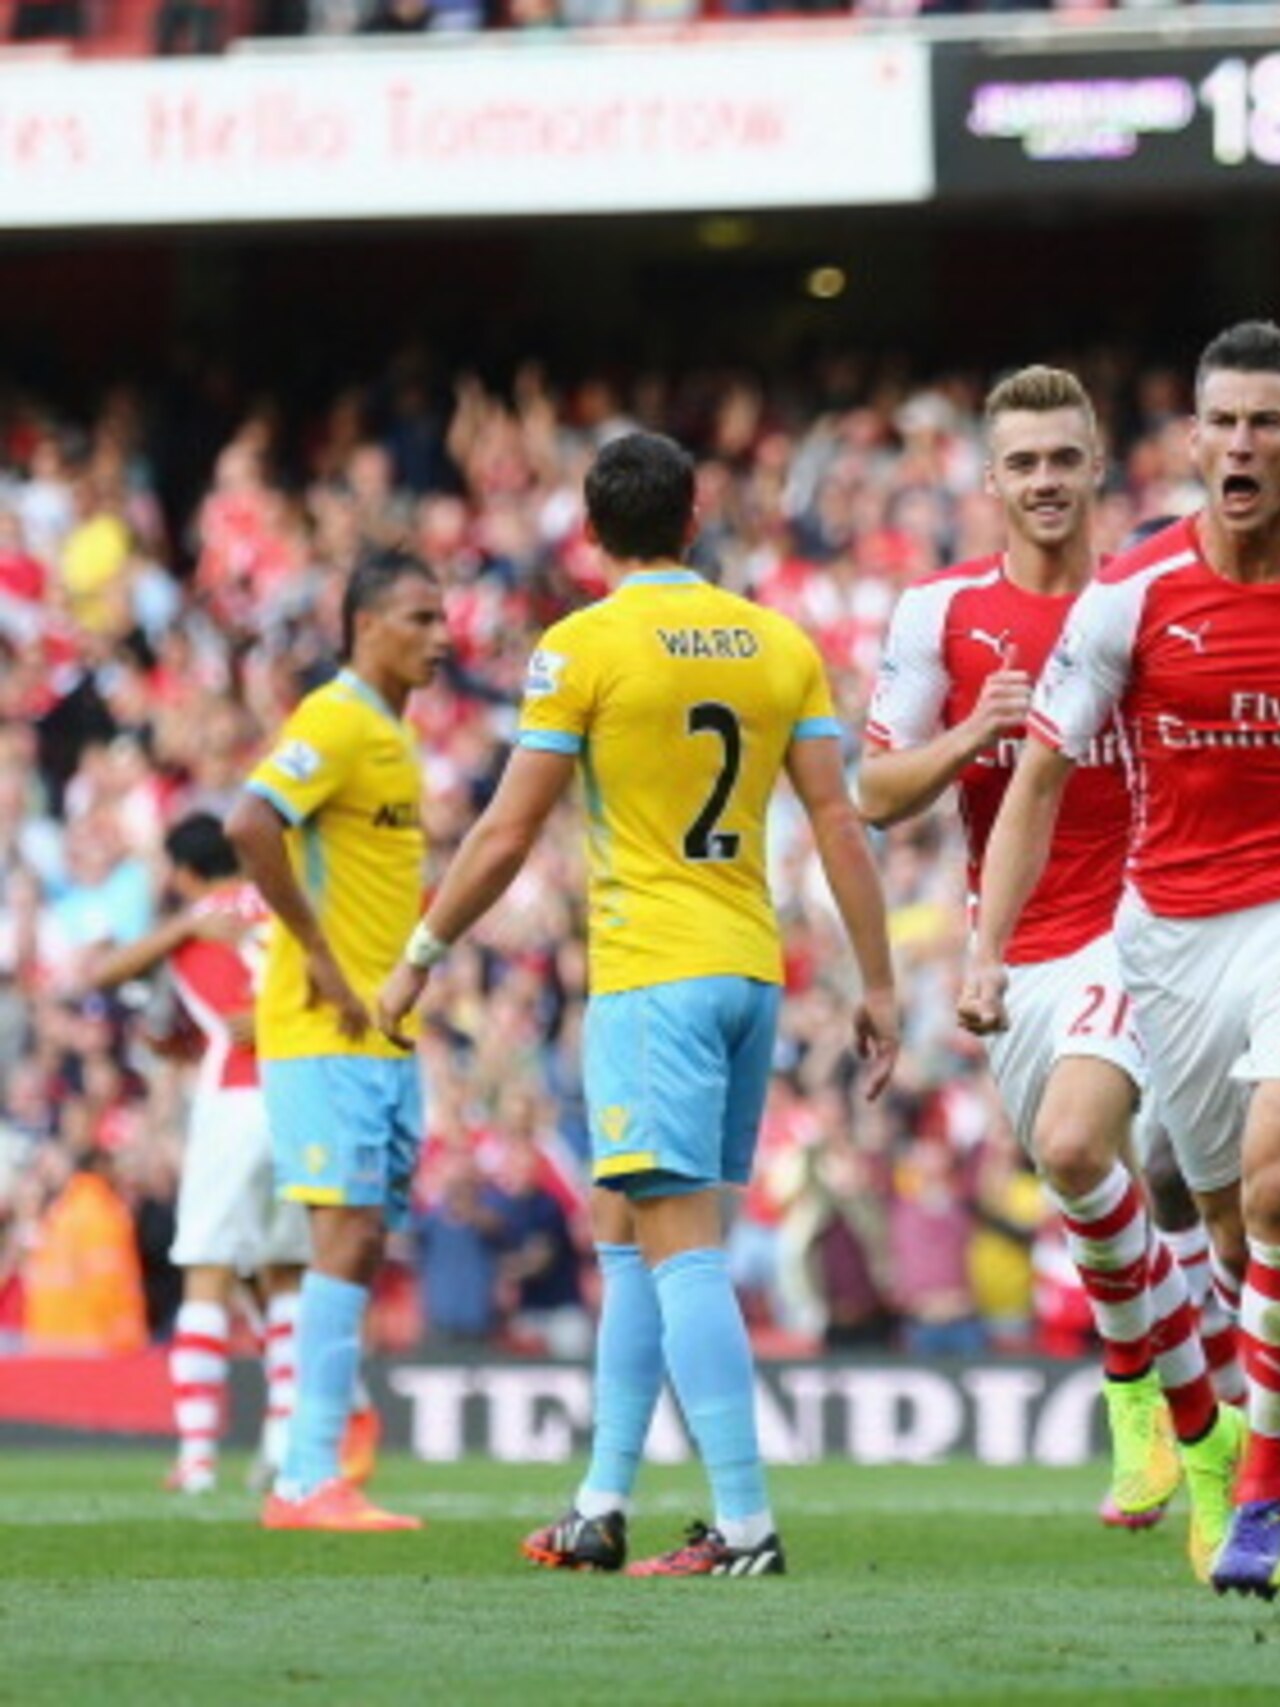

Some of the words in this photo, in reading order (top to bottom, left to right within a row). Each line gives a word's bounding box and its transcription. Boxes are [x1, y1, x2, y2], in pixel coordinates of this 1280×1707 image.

[658, 629, 758, 659] WARD
[684, 703, 741, 860] 2
[1068, 984, 1130, 1036] 21
